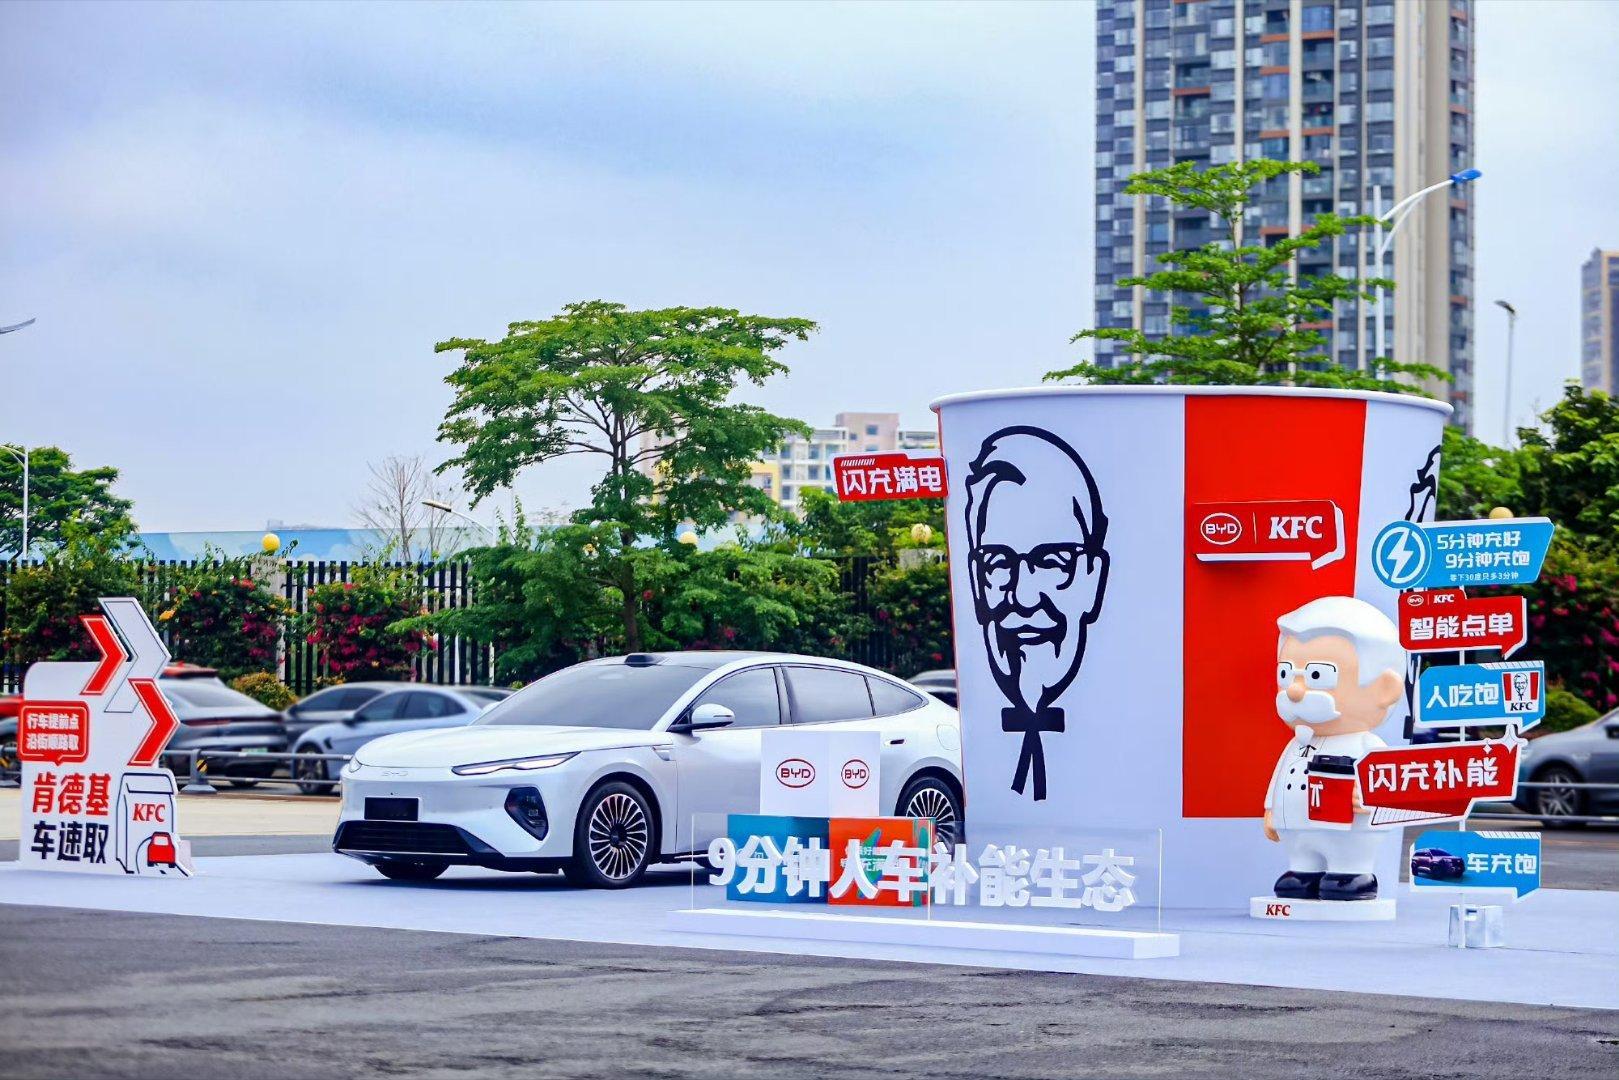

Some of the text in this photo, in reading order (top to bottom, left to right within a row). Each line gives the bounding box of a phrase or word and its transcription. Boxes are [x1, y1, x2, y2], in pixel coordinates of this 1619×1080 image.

[842, 465, 942, 495] 闪充满电
[1268, 516, 1323, 540] KFC
[1437, 531, 1521, 550] 5分钟充好
[1445, 550, 1530, 569] 9分钟充饱
[1433, 593, 1455, 604] KFC
[1410, 612, 1514, 641] 智能点单
[1426, 682, 1499, 709] 人吃饱
[1510, 701, 1533, 712] KFC
[26, 713, 79, 730] 行车提前点
[1368, 757, 1499, 792] 闪充补能
[32, 772, 111, 816] 肯德基
[132, 803, 166, 822] KFC
[31, 820, 110, 864] 车速取
[708, 835, 1136, 912] 9分钟人车补能生态
[1467, 852, 1537, 876] 车充饱
[1266, 904, 1291, 917] KFC
